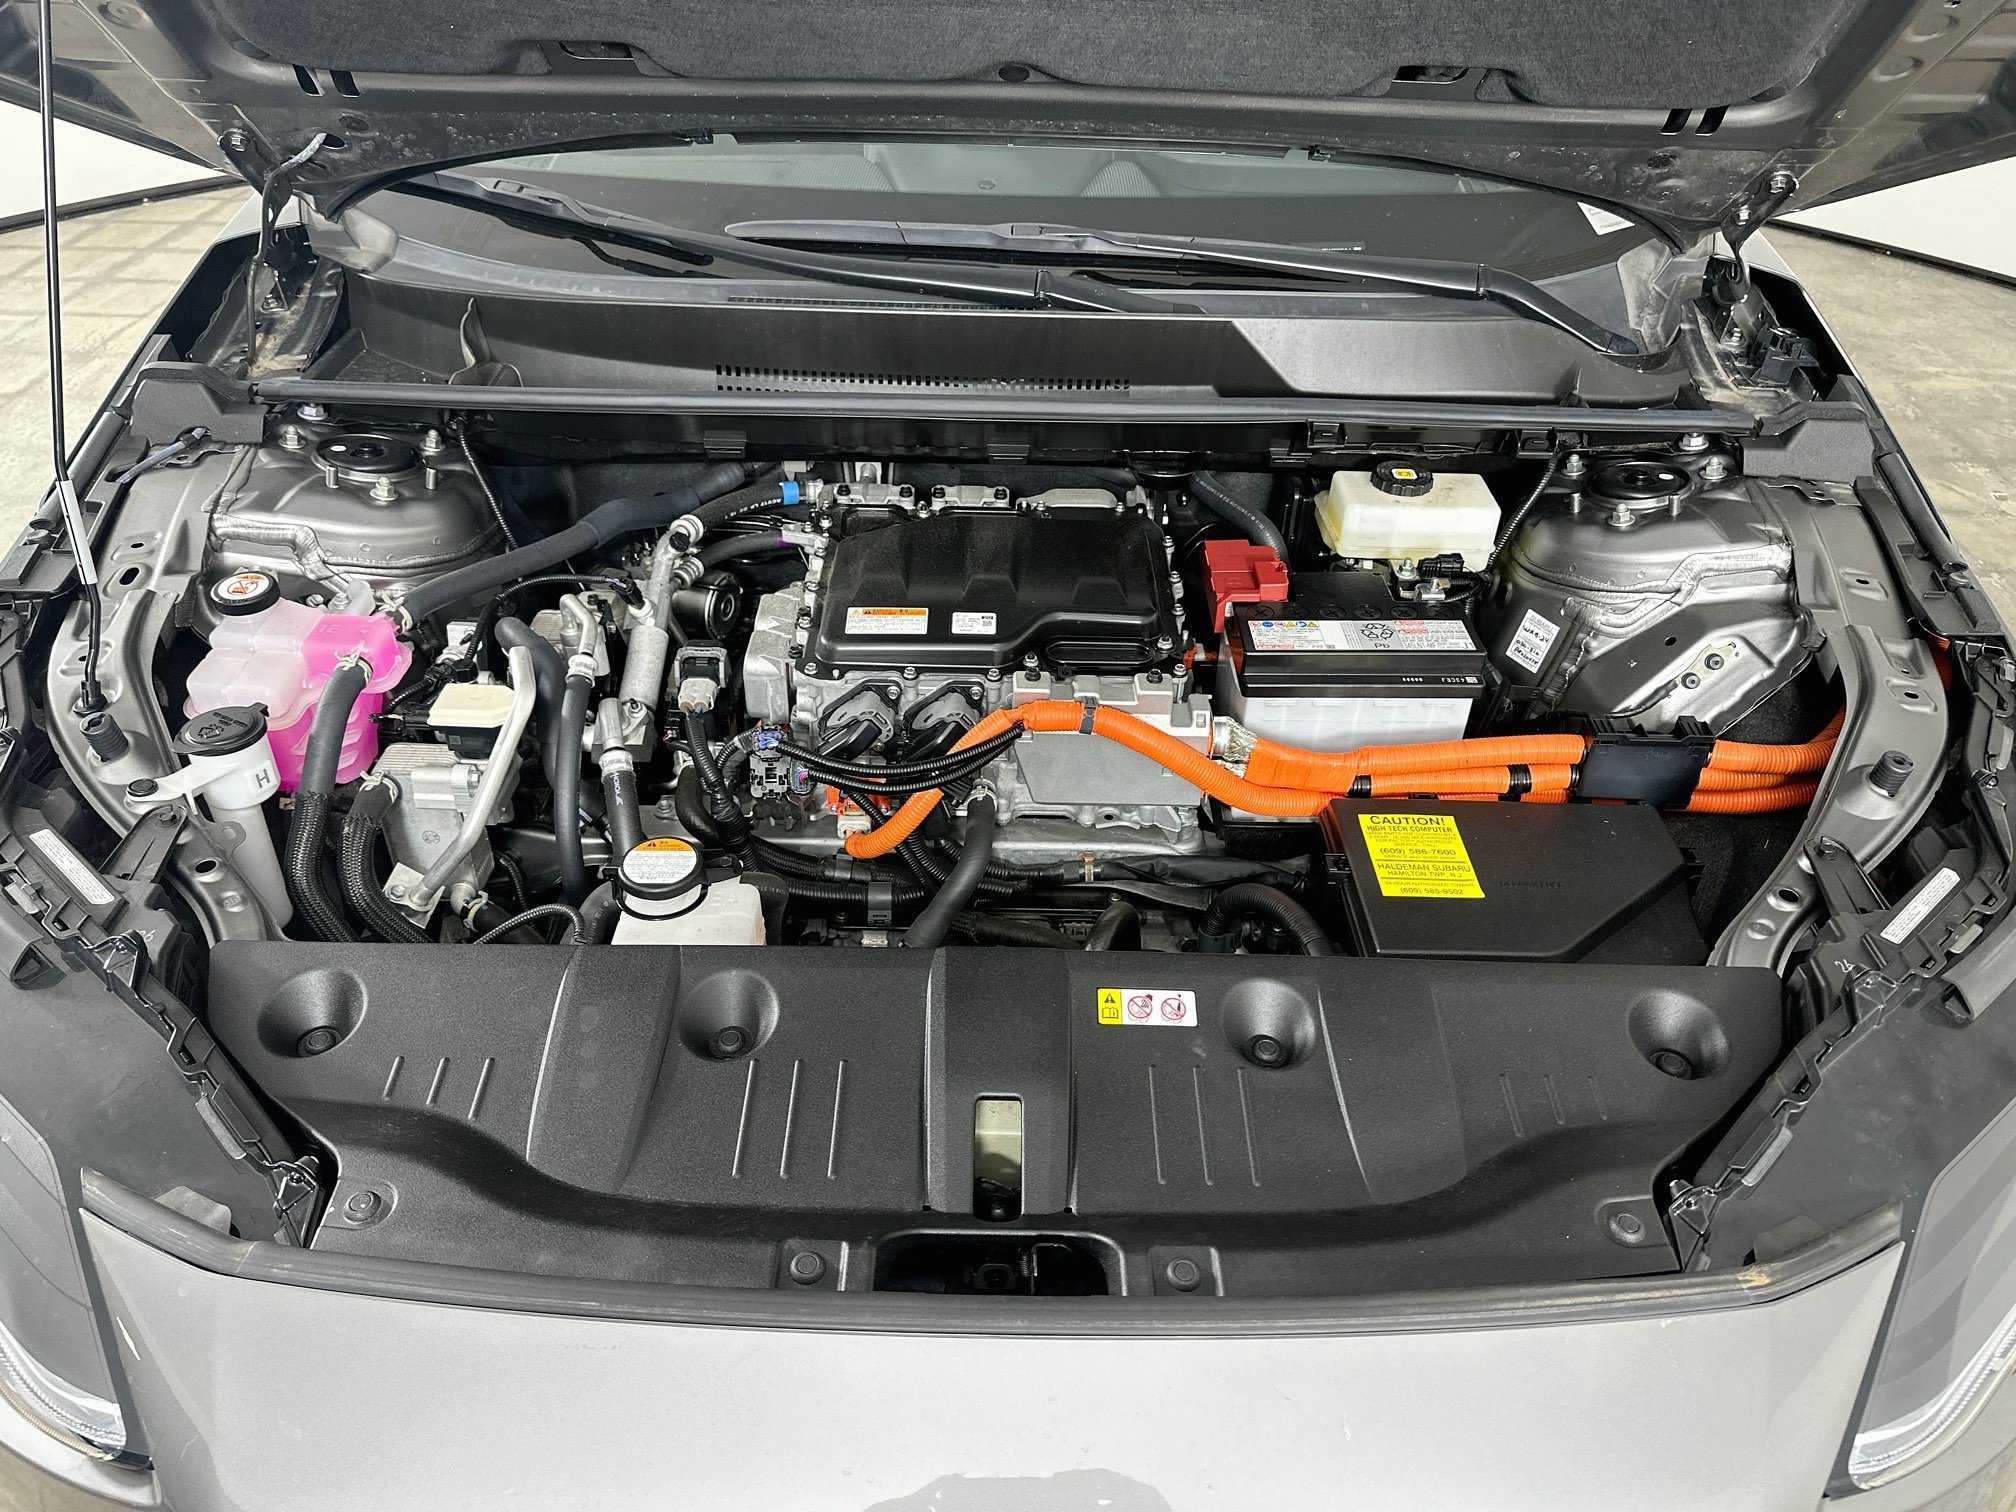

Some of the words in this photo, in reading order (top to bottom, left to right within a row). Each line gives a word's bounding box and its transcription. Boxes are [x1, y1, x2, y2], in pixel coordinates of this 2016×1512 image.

[255, 768, 271, 788] H
[1370, 815, 1446, 826] CAUTION!
[1380, 847, 1406, 855] (609)
[1408, 848, 1456, 856] 586-7600
[1378, 863, 1430, 871] HALDEMAN
[1432, 864, 1471, 872] SUBARU
[1400, 887, 1422, 895] (609)
